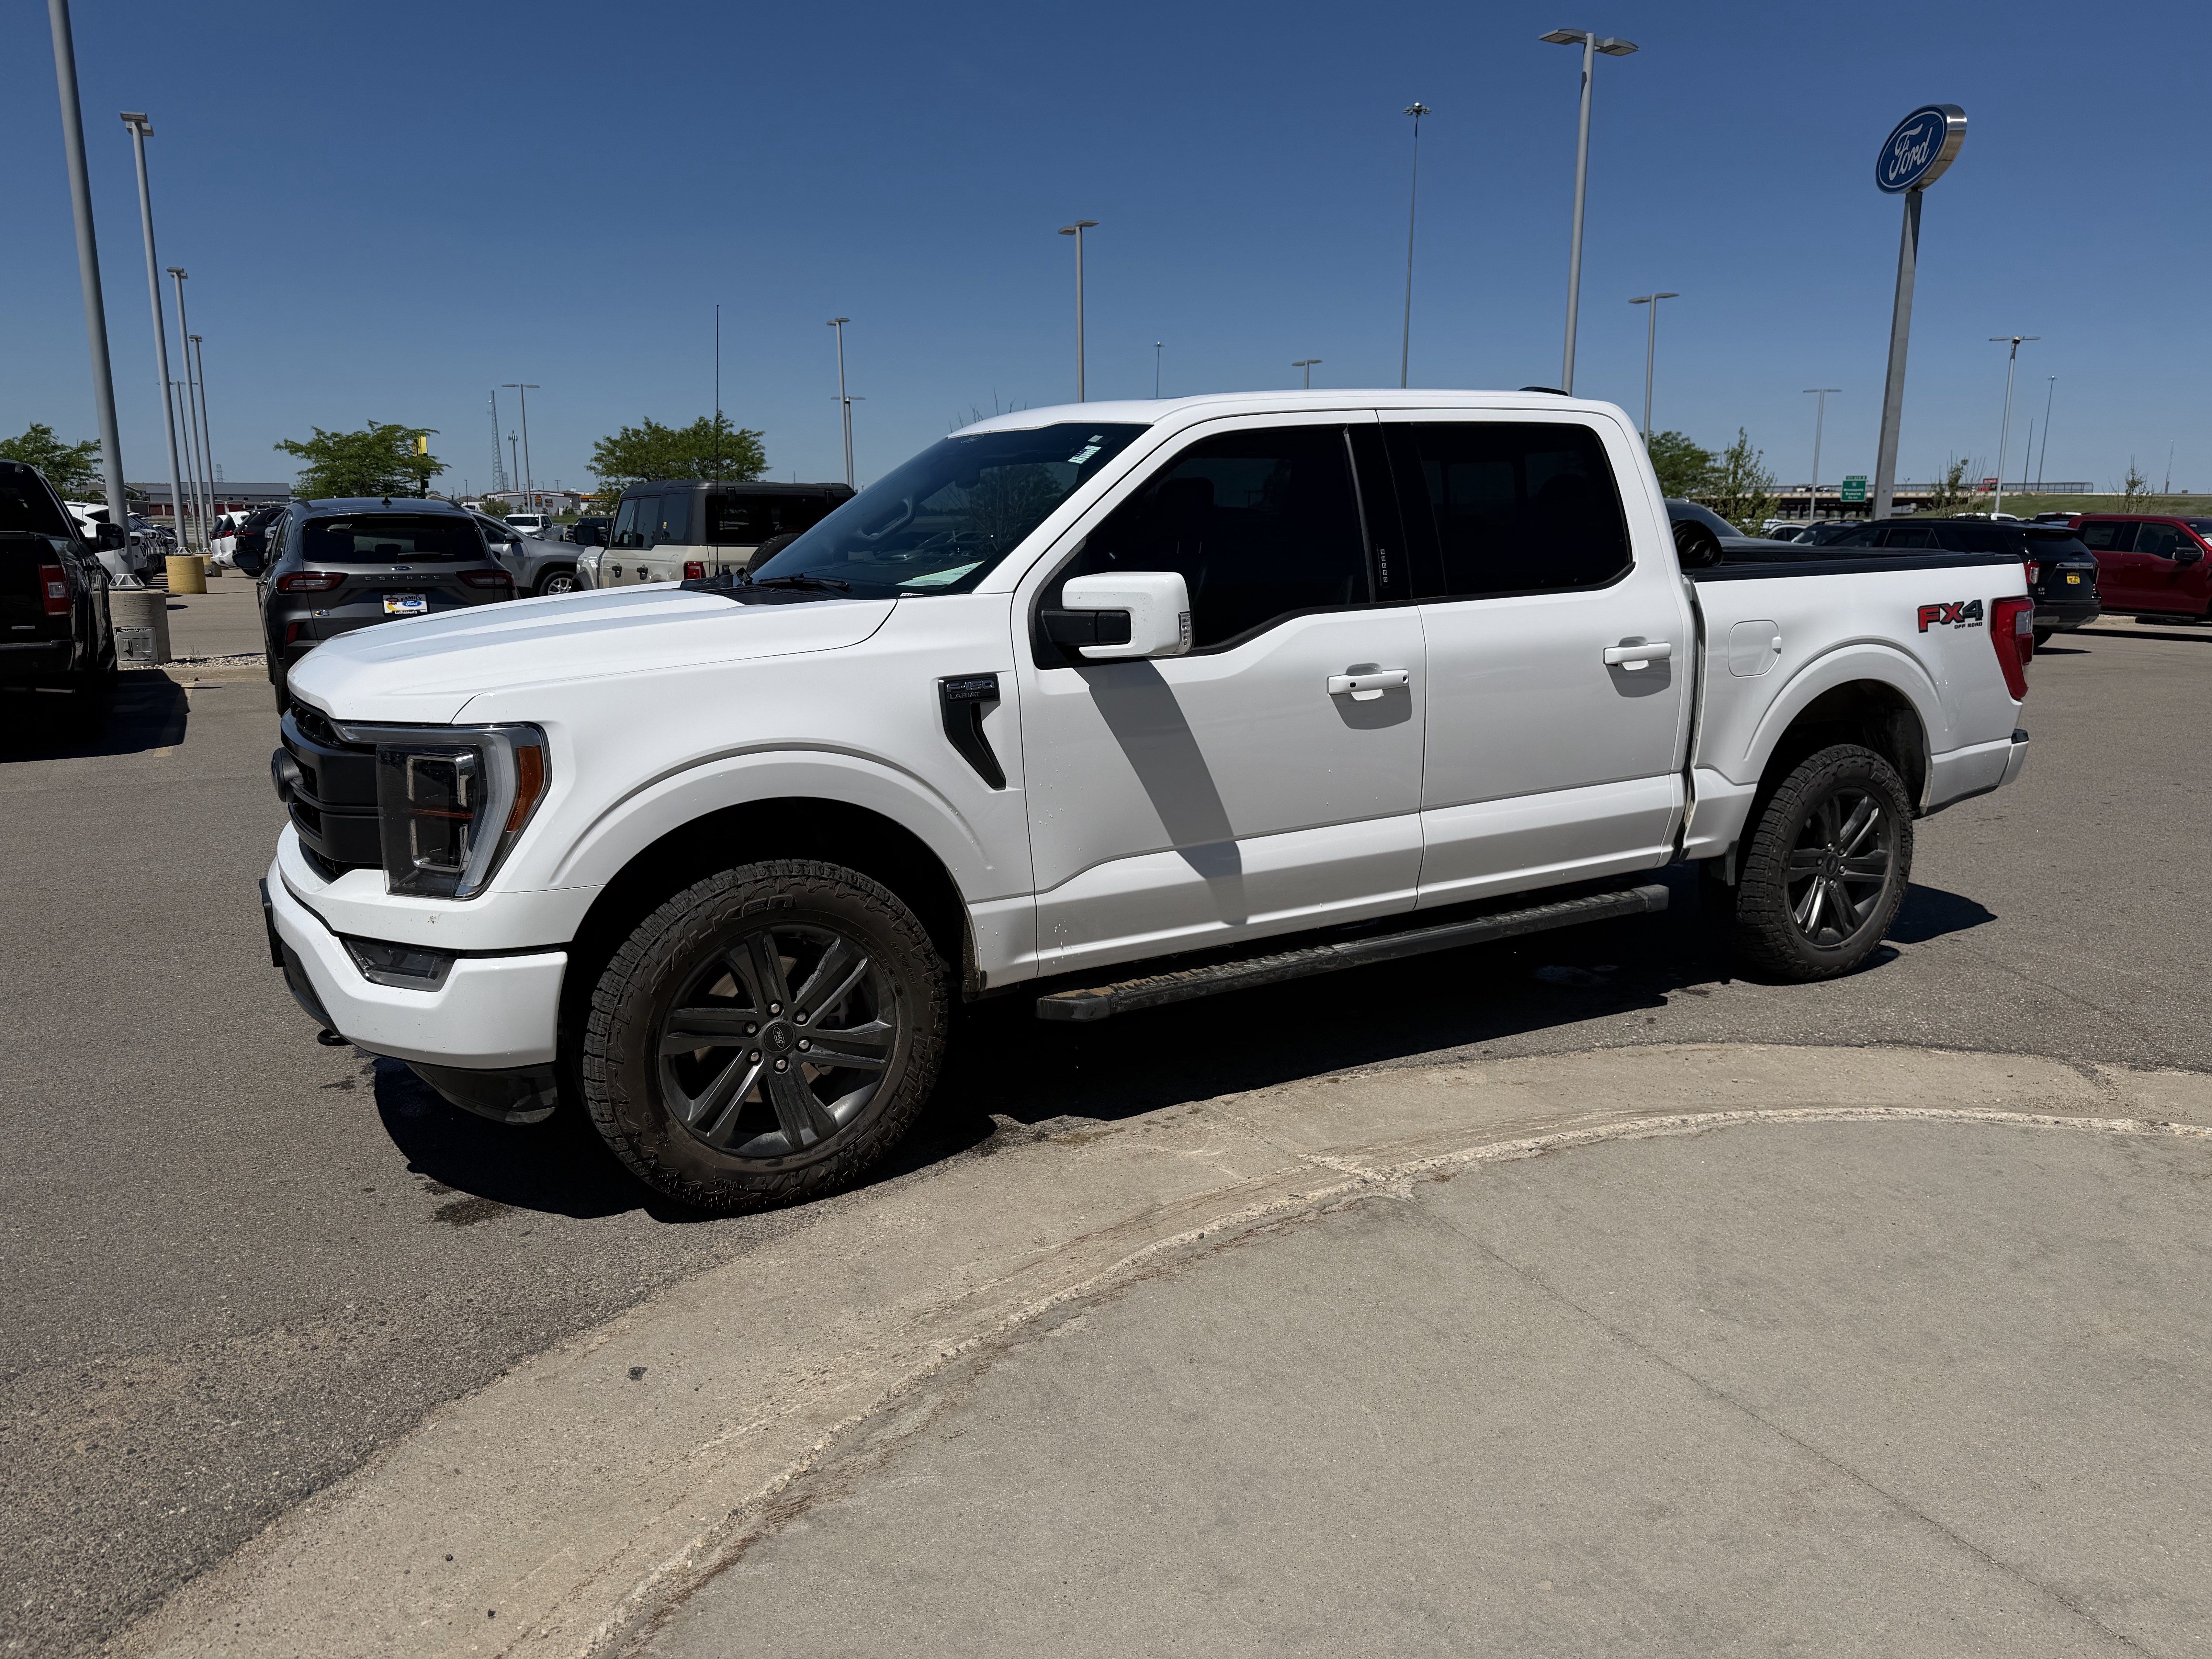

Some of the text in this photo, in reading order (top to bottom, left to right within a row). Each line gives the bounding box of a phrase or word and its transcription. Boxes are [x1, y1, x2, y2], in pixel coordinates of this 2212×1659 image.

[1889, 123, 1933, 181] Ford
[1917, 599, 1984, 634] FX4
[946, 679, 994, 693] F-150
[775, 1030, 784, 1044] Ford
